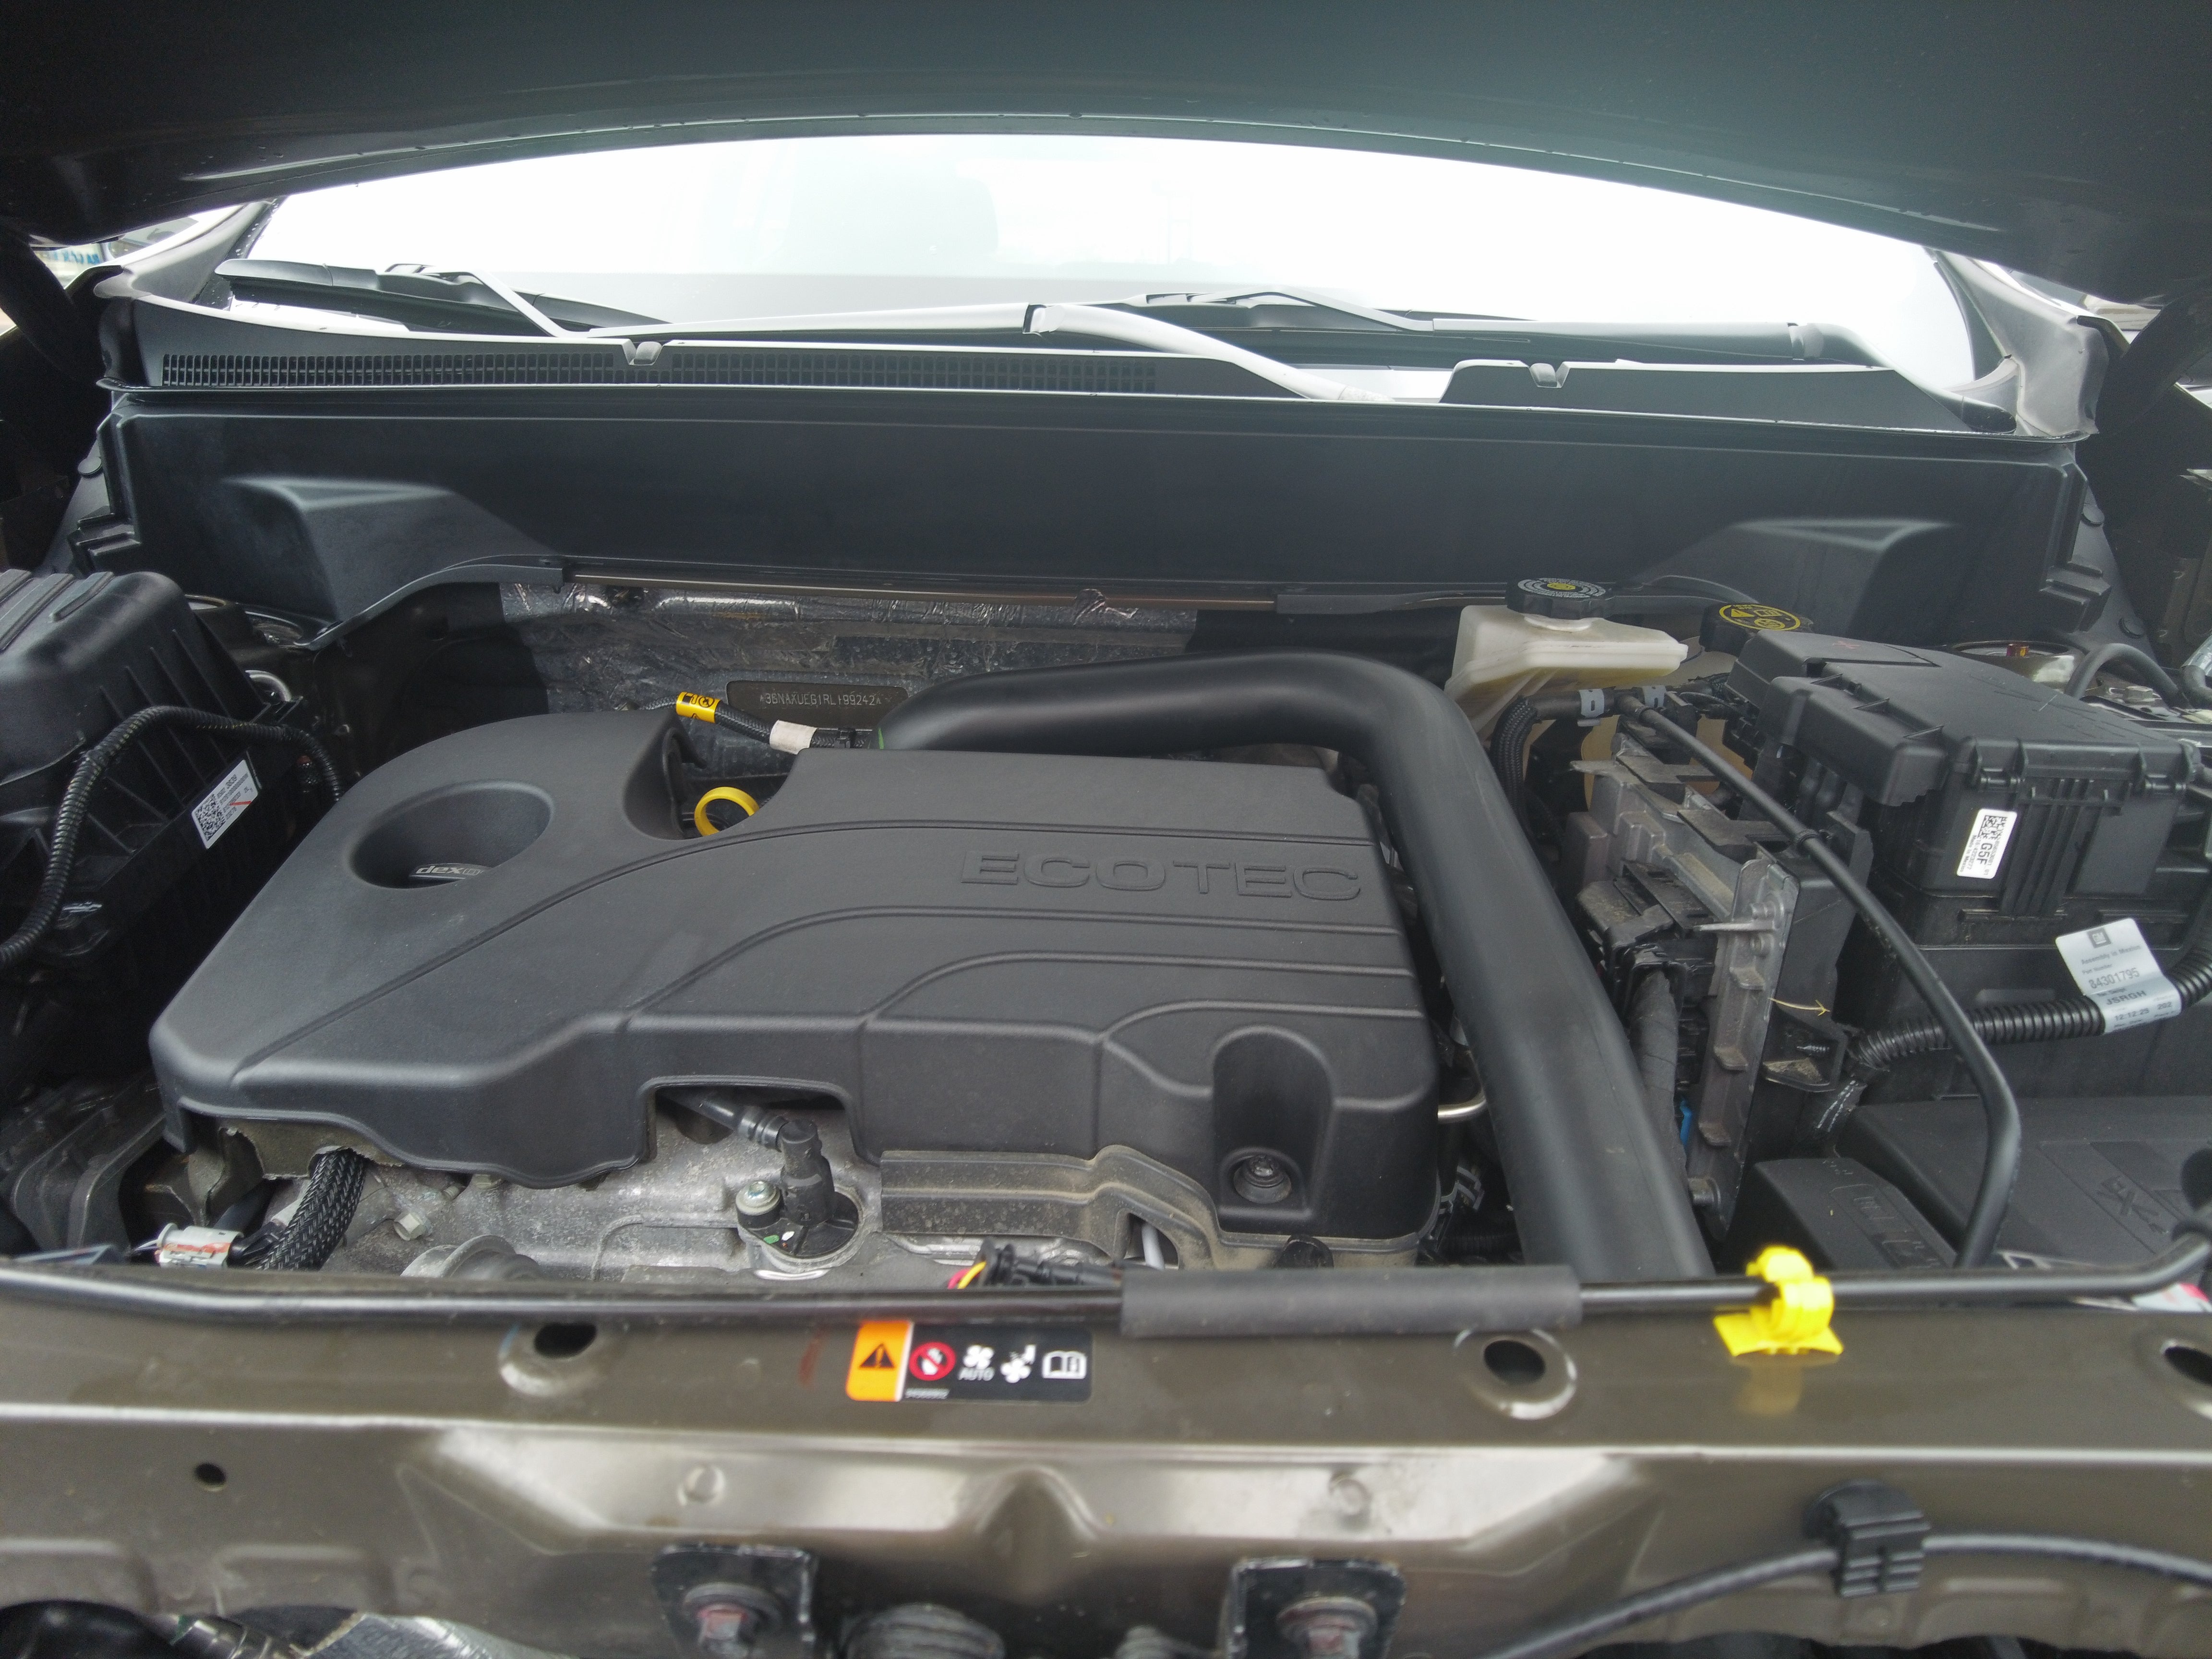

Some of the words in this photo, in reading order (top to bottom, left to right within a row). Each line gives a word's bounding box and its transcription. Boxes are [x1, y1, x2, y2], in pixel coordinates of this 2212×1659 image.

[1977, 843, 1993, 865] G5F
[416, 866, 484, 876] dexo
[961, 851, 1361, 901] ECOTEC
[2088, 967, 2140, 989] 84301795
[2106, 990, 2147, 1005] JSRGH
[958, 1367, 995, 1382] AUTO
